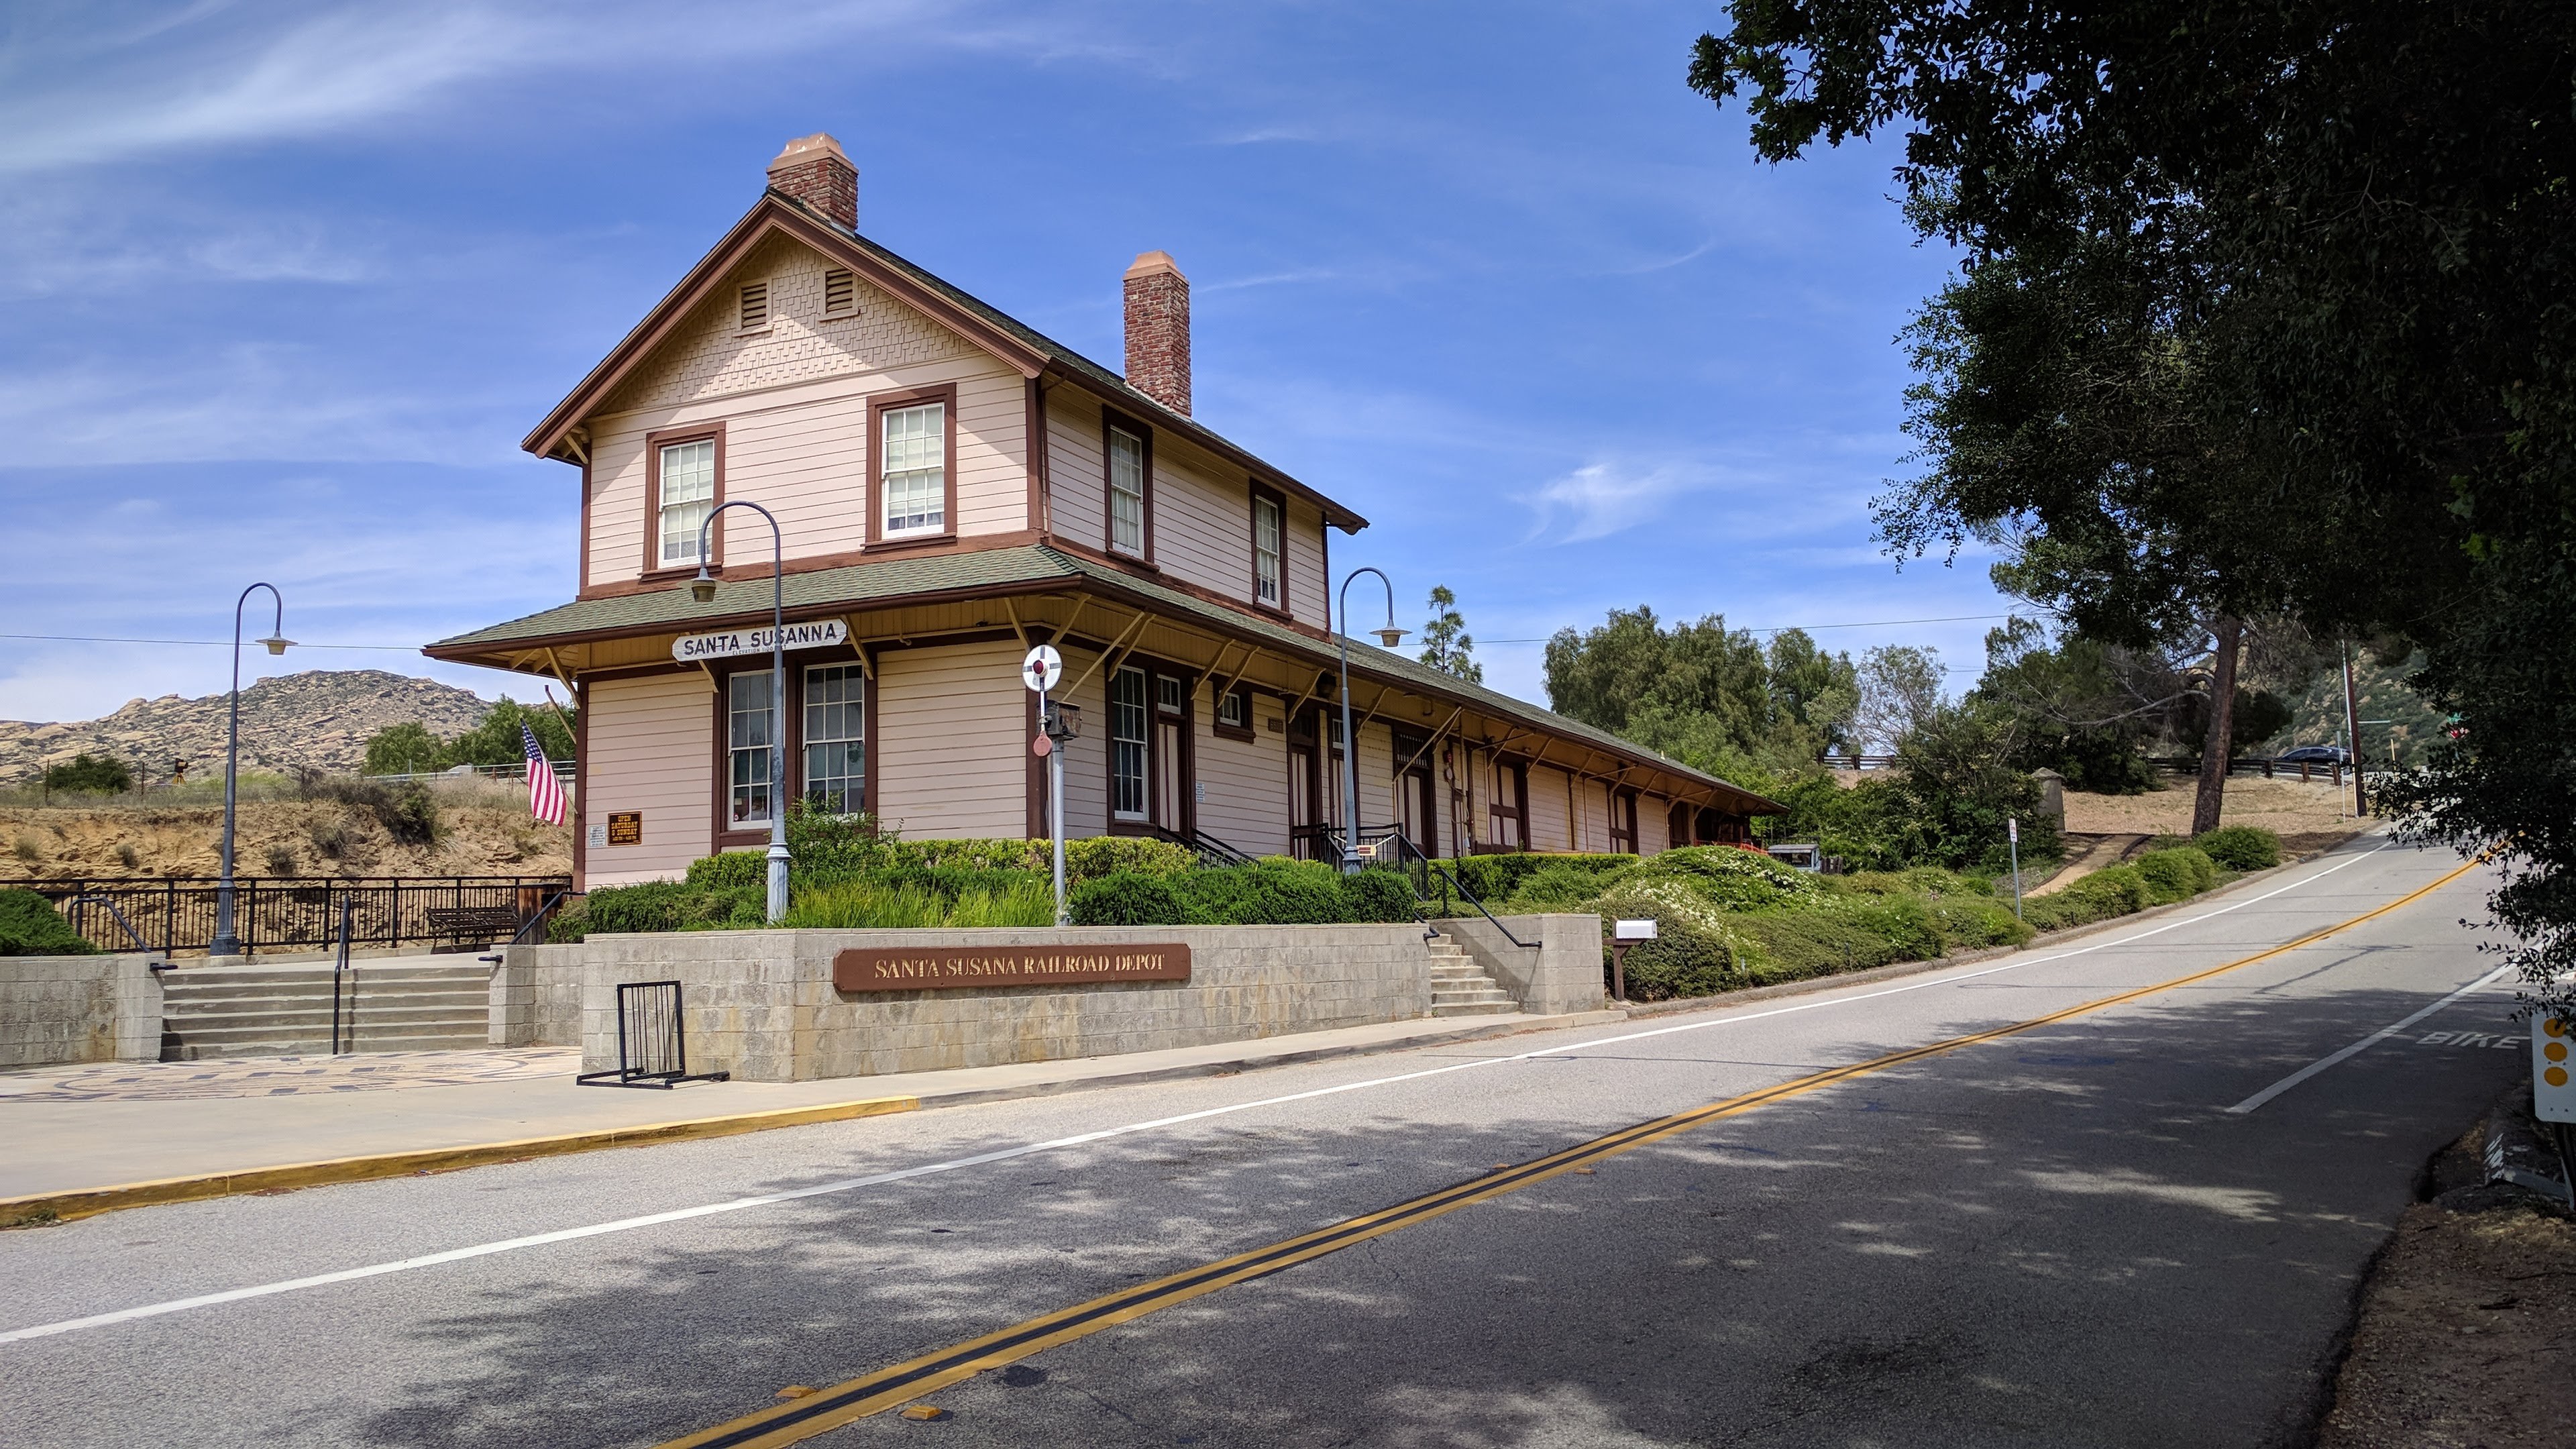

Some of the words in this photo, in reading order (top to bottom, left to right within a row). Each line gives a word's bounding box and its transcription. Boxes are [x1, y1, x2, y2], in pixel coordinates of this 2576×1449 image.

[684, 634, 740, 656] SANTA
[751, 623, 838, 648] SUSANNA
[733, 647, 760, 655] ELEVATION
[875, 958, 939, 978] SANTA
[946, 956, 1017, 977] SUSANA
[1024, 954, 1110, 974] RAILROAD
[1116, 953, 1165, 971] DEPOT
[2416, 1031, 2532, 1049] BIKE
